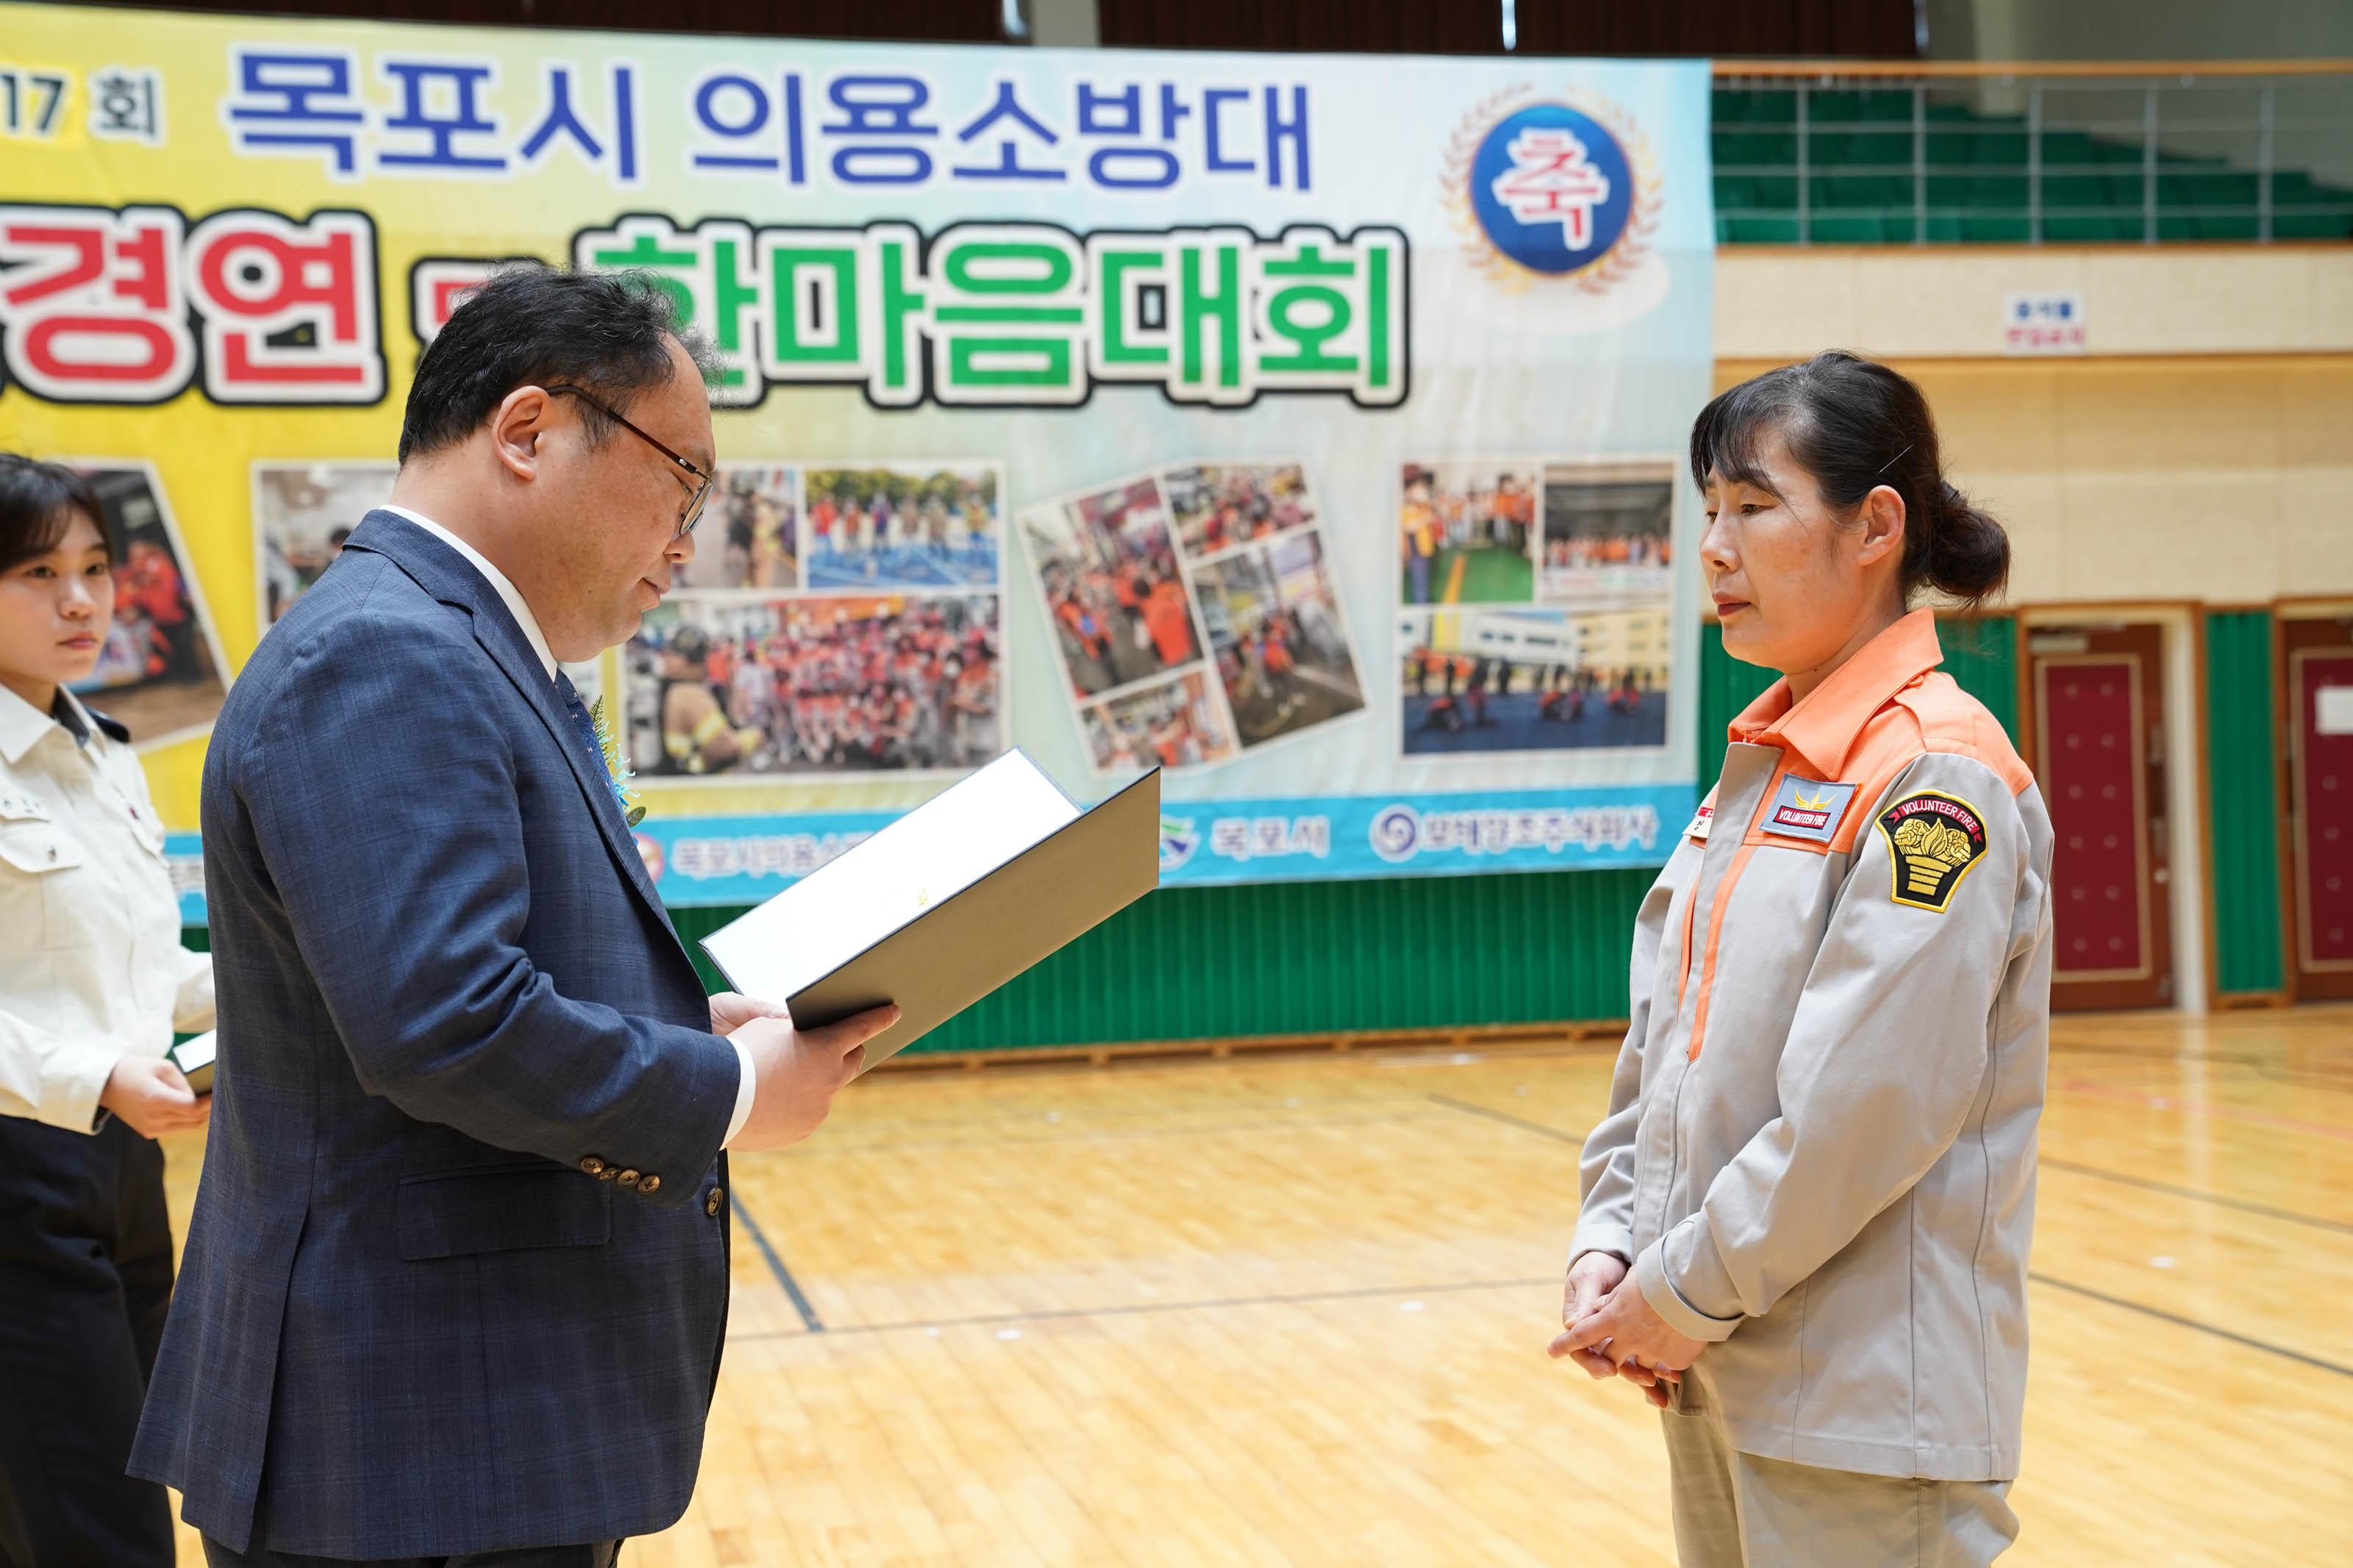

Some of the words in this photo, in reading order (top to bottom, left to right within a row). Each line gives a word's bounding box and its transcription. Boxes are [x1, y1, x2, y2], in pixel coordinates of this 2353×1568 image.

[0, 73, 65, 132] 17
[96, 71, 156, 137] 회
[229, 53, 638, 181] 목포시
[692, 71, 1313, 193] 의용소방대
[1500, 134, 1602, 243] 축
[3, 226, 365, 386] 경연
[593, 235, 1390, 389] 한마음대회
[1215, 817, 1328, 858] 목포시
[1778, 809, 1815, 826] VOLUNTEER
[1812, 814, 1828, 826] FIRE
[1902, 800, 1958, 817] VOLUNTEER
[1957, 810, 1978, 831] FIRE
